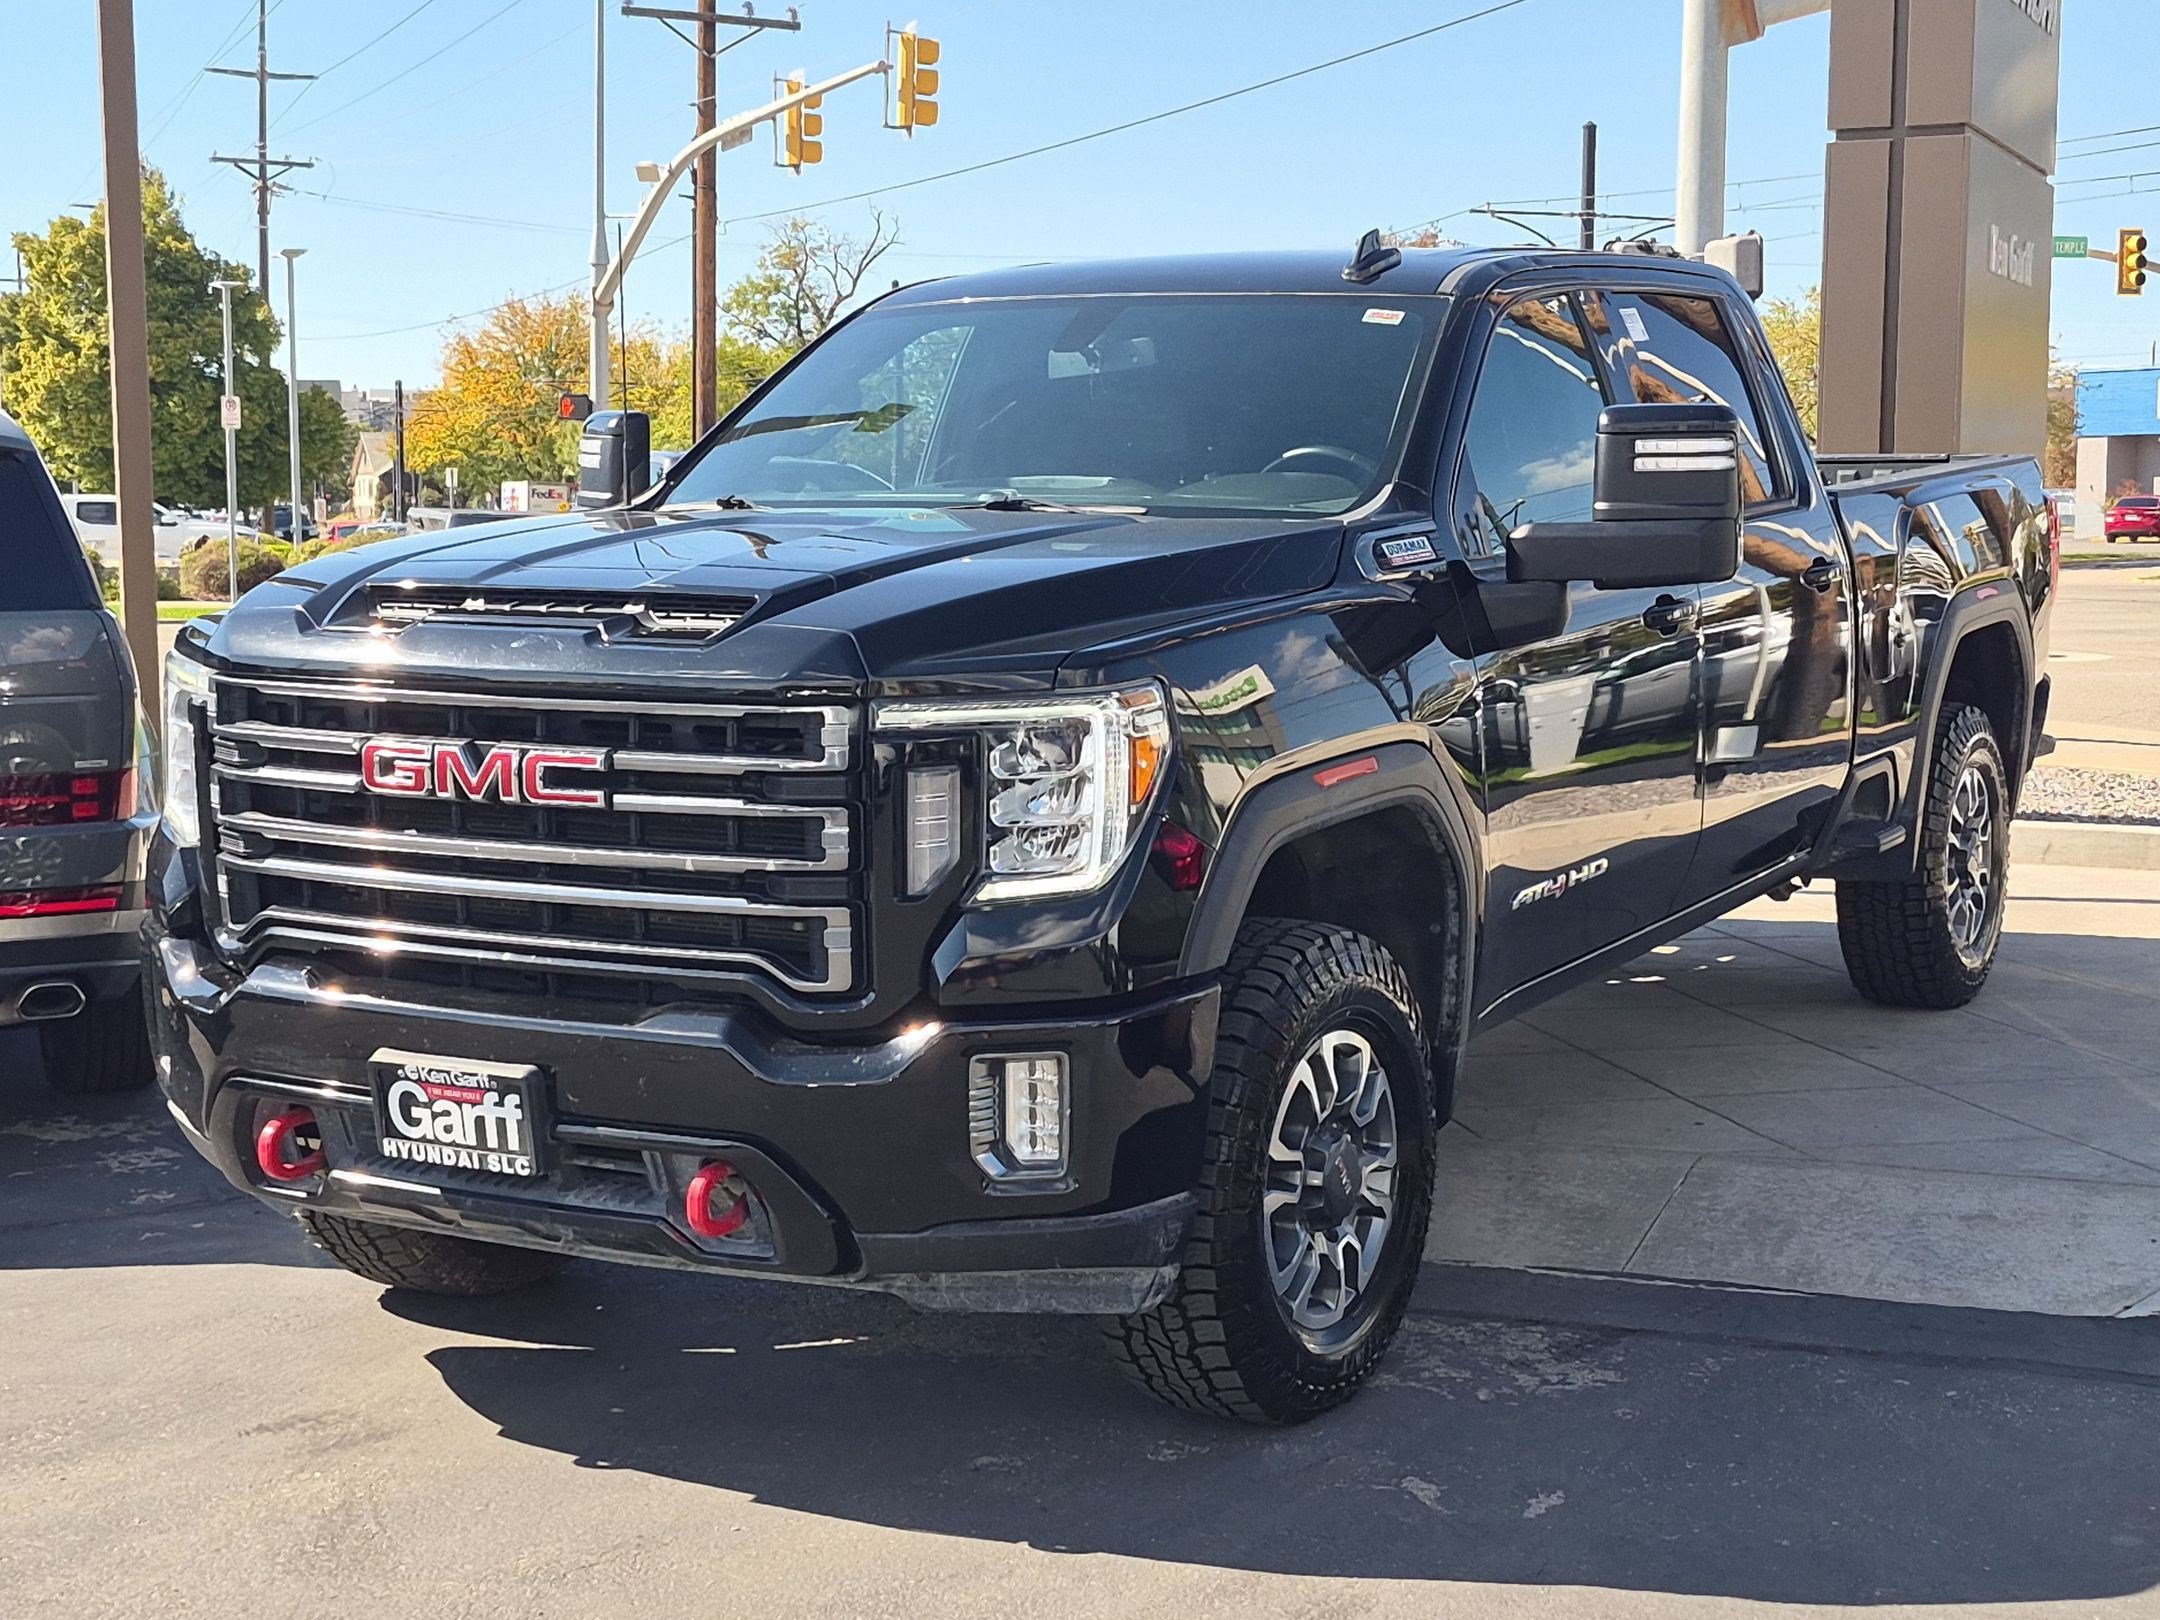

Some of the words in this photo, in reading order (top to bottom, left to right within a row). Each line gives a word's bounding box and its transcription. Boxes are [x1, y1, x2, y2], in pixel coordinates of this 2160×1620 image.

[2055, 241, 2085, 254] TEMPLE
[531, 487, 564, 500] FedEx
[362, 740, 608, 808] GMC
[387, 1080, 523, 1151] Garff
[382, 1138, 481, 1170] HYUNDAI
[486, 1154, 531, 1176] SLC
